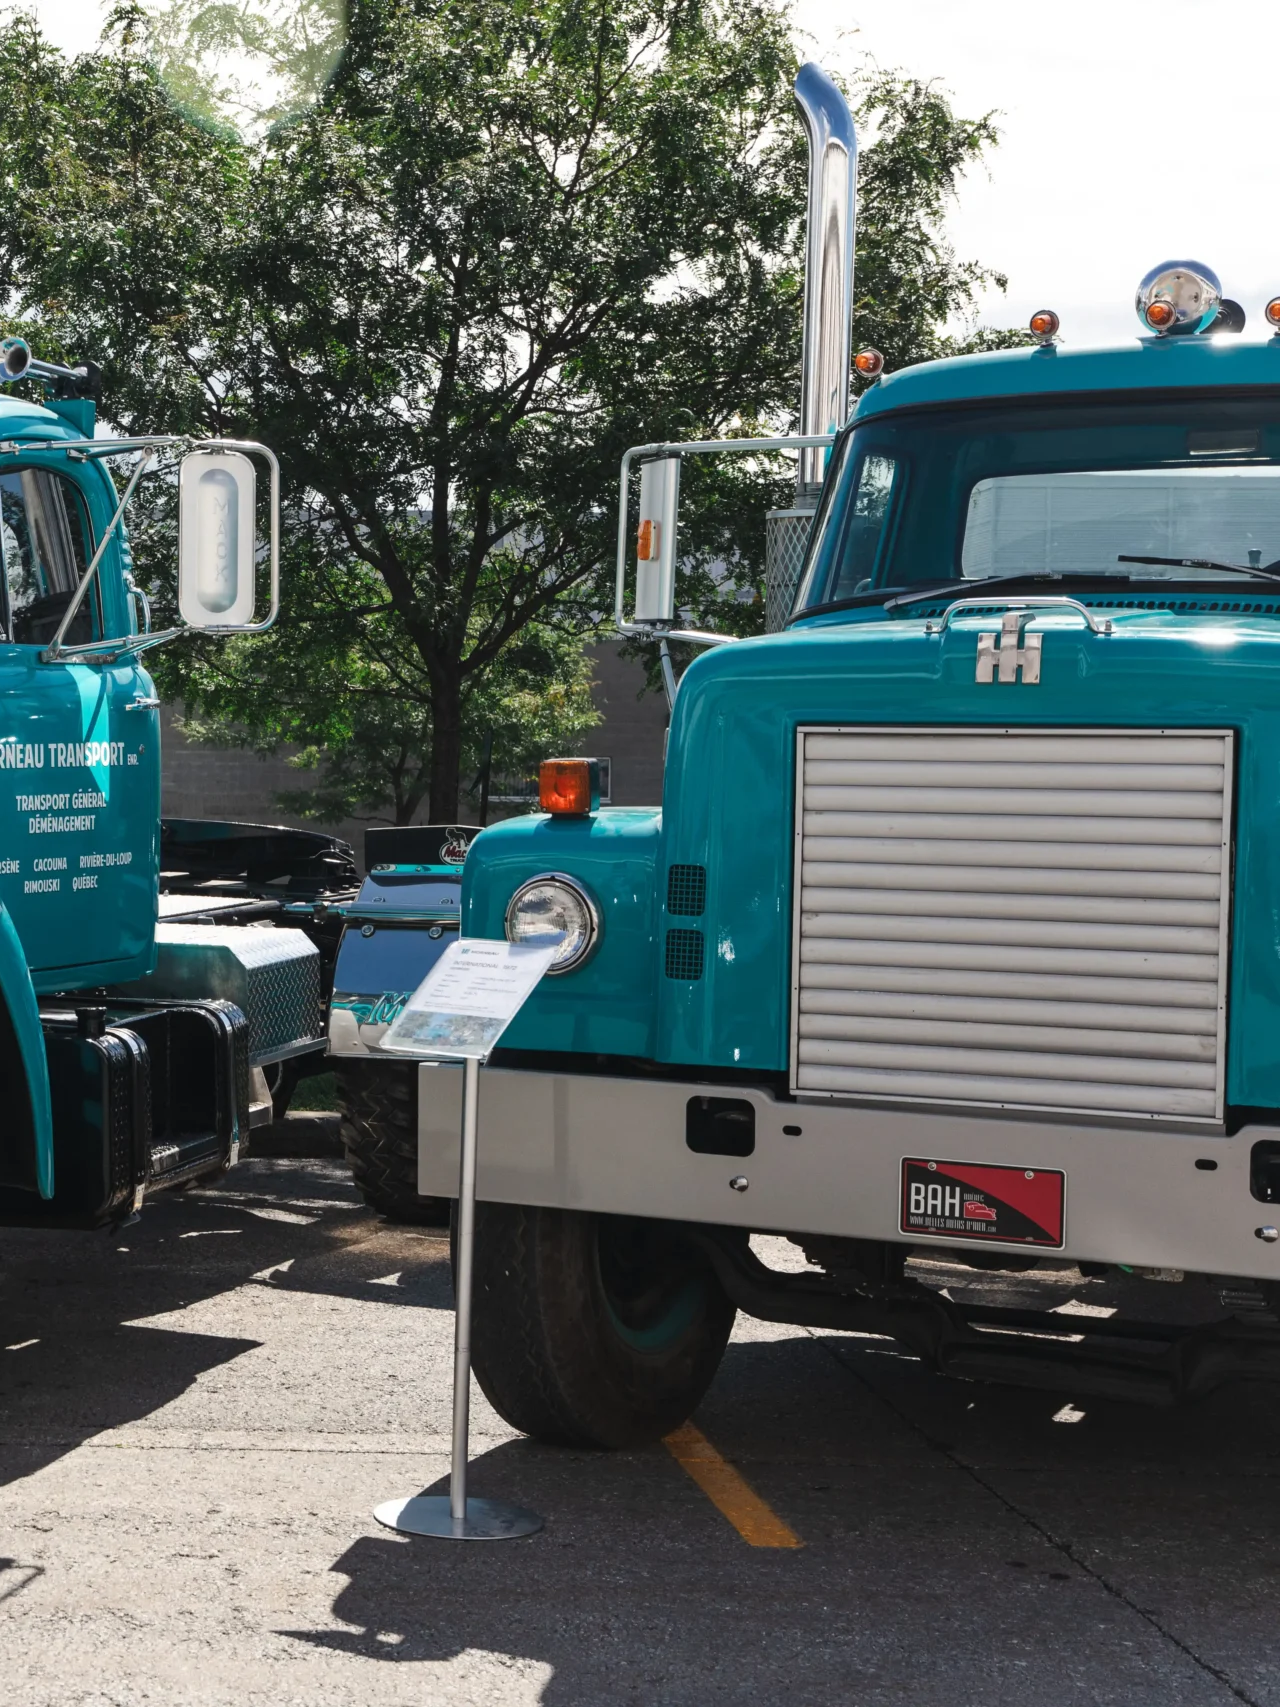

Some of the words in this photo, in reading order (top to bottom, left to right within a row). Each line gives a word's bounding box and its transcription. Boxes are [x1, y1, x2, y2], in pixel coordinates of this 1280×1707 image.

[48, 742, 125, 767] TRANSPORT
[16, 793, 70, 811] TRANSPORT
[72, 788, 106, 809] GÉNÉRAL
[29, 814, 96, 834] DÉMÉNAGEMENT
[33, 857, 67, 872] CACOUNA
[79, 851, 133, 869] RIVIÈRE-DU-LOUP
[443, 845, 467, 858] Mac
[24, 878, 60, 894] RIMOUSKI
[72, 873, 98, 892] QUÉBEC
[453, 960, 498, 969] INTERNATIONAL
[910, 1182, 960, 1218] BAH
